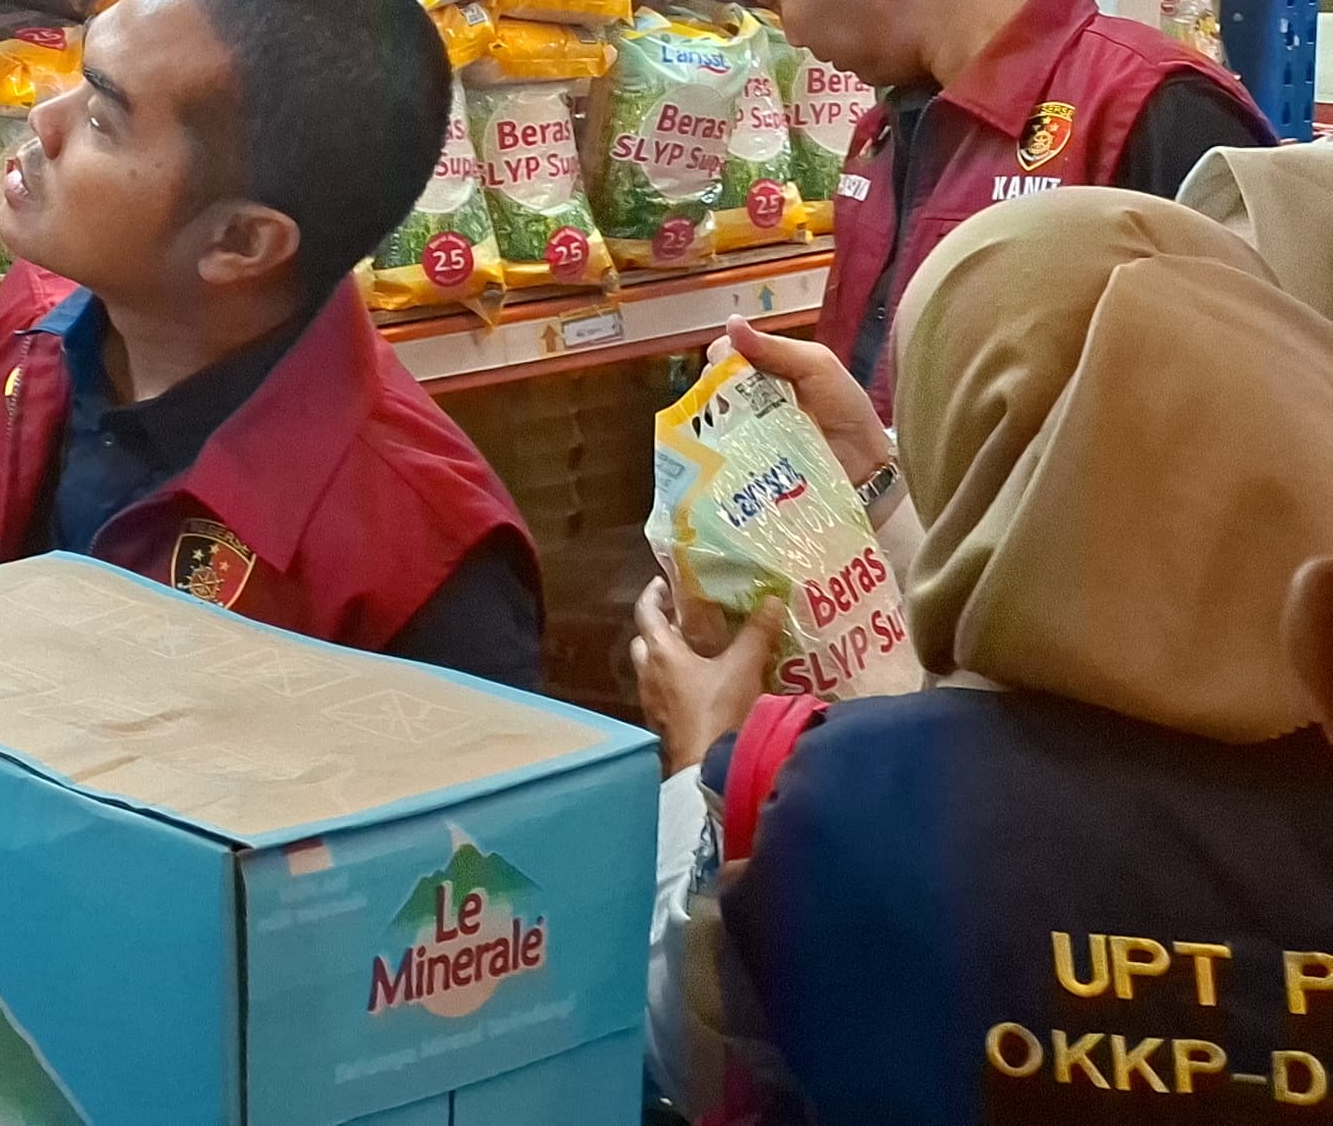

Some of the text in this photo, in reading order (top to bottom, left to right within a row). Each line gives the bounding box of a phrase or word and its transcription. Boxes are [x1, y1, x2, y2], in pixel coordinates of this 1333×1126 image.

[656, 103, 727, 141] Beras
[1041, 104, 1074, 119] SERSE
[496, 118, 571, 151] Beras
[610, 134, 684, 167] SLYP
[755, 195, 780, 215] 25
[555, 242, 583, 265] 25
[662, 231, 687, 250] 25
[432, 248, 465, 272] 25
[803, 546, 887, 628] Beras
[779, 625, 869, 697] SLYP
[434, 879, 483, 944] Le
[1050, 929, 1233, 1007] UPT
[984, 1021, 1327, 1106] OKKP-D
